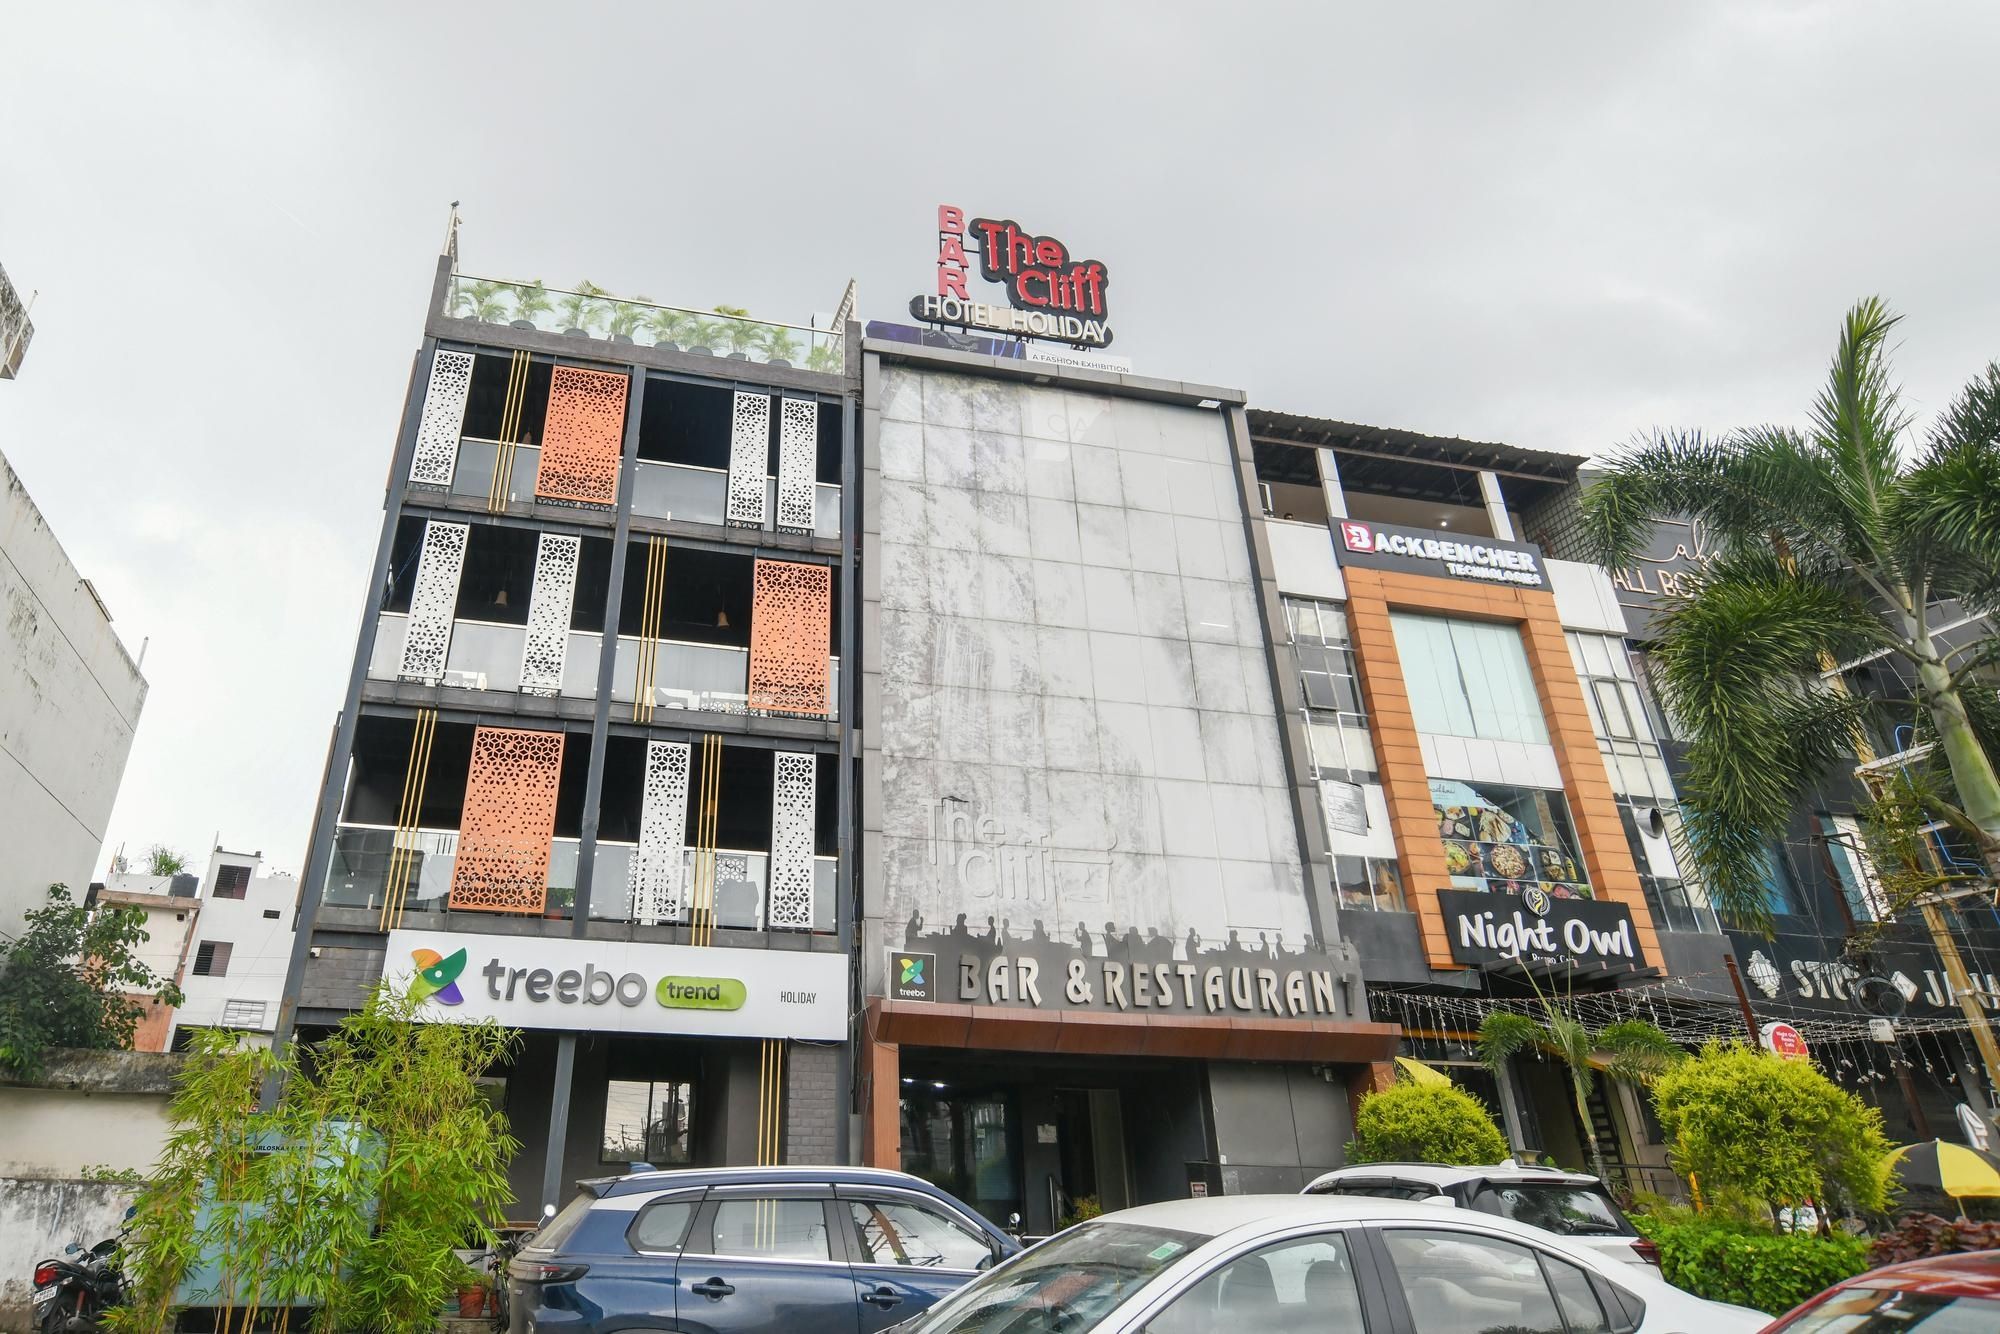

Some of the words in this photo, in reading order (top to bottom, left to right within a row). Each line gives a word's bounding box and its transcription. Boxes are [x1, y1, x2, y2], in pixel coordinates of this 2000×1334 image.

[938, 204, 970, 300] BAR
[978, 221, 1064, 275] The
[1016, 263, 1103, 315] Cliff
[923, 294, 1001, 328] HOTEL
[1010, 308, 1109, 343] HOLIDAY
[1040, 355, 1079, 366] FASHION
[1081, 360, 1129, 373] EXHIBITION
[1446, 562, 1542, 586] TECHNOLOGIES
[1457, 911, 1557, 960] Night
[1563, 918, 1634, 958] Owl
[482, 957, 648, 1008] treebo
[666, 981, 721, 1002] trend
[779, 991, 817, 1005] HOLIDAY
[899, 988, 926, 997] treebo
[958, 954, 1042, 1007] BAR
